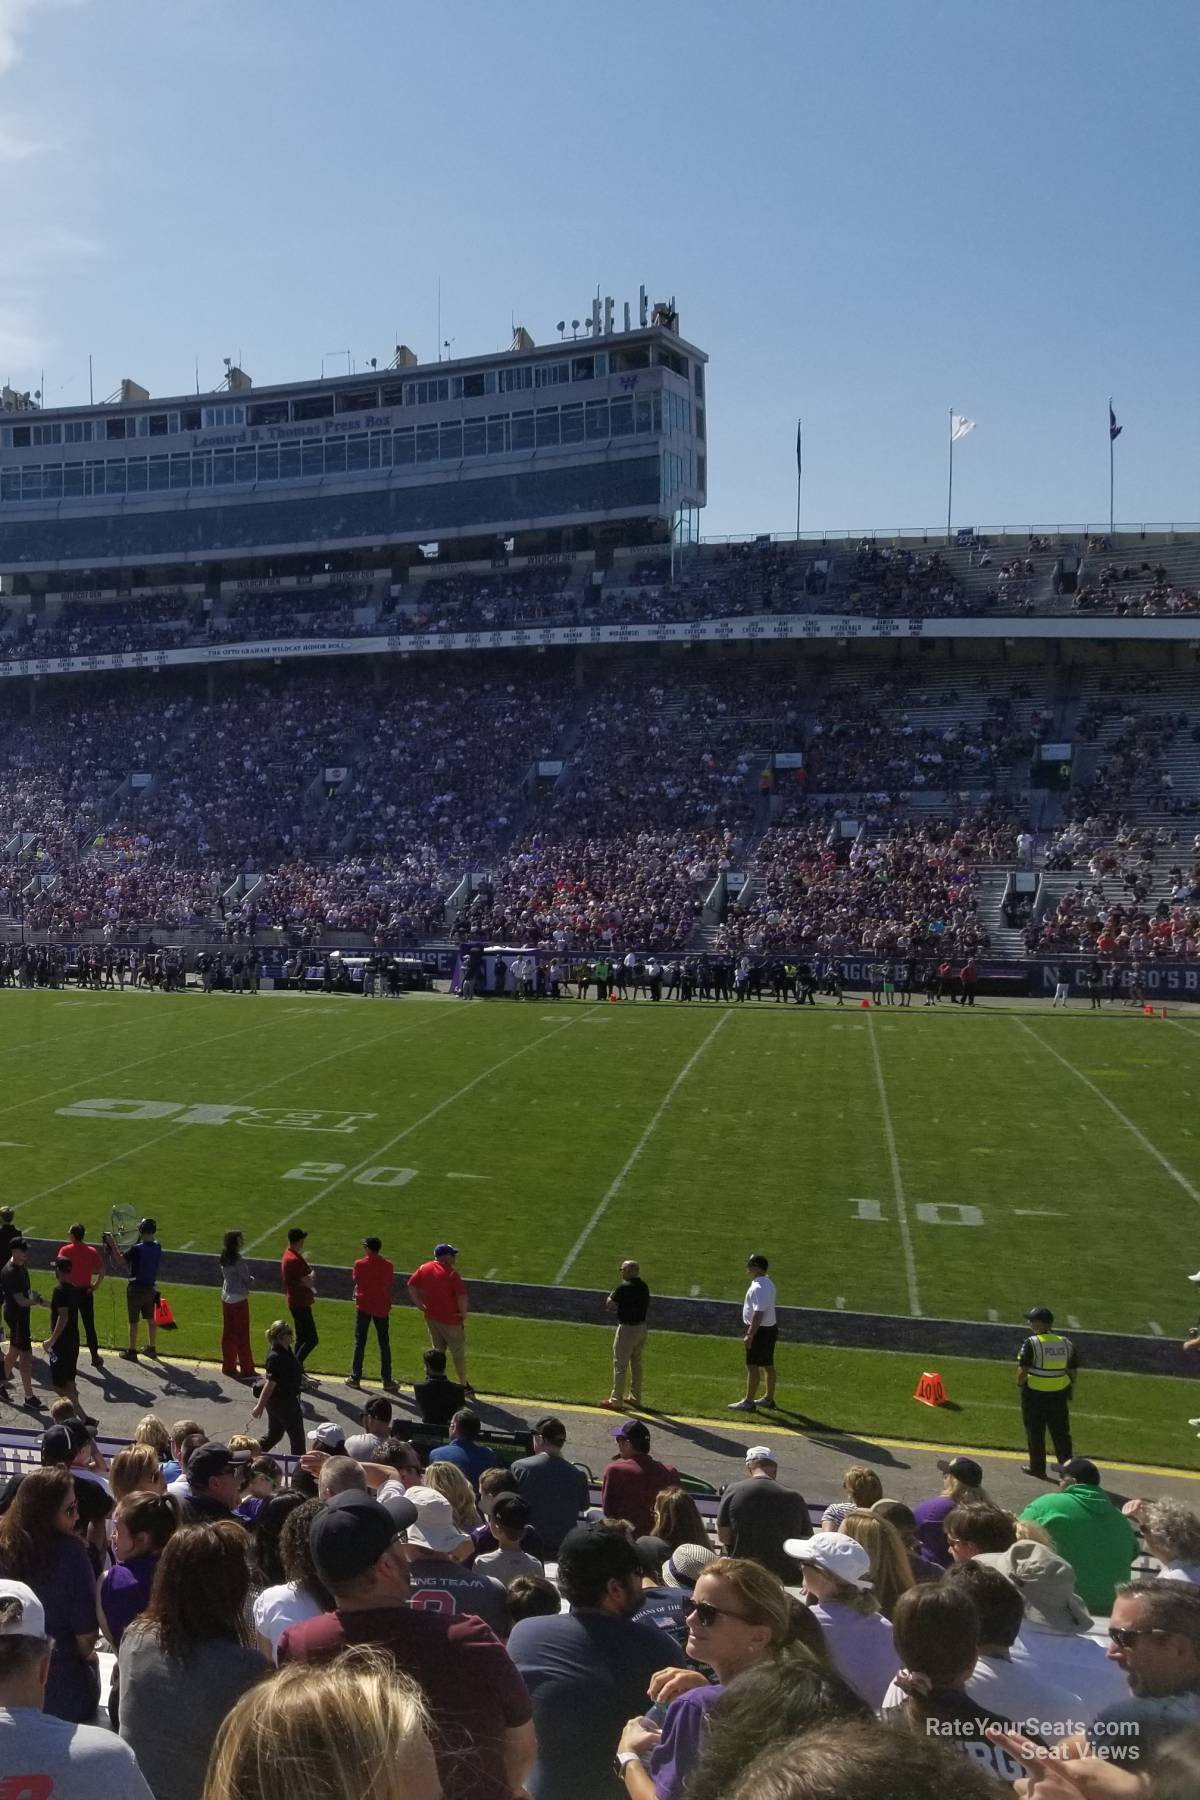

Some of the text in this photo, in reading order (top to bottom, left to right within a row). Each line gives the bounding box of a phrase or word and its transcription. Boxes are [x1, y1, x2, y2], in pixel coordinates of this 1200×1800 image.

[193, 430, 246, 447] Leonard
[269, 423, 320, 439] Thomas
[324, 418, 361, 433] Press
[365, 413, 391, 427] Box
[241, 647, 270, 655] GRAHAM
[281, 1161, 419, 1186] 20
[848, 1198, 984, 1226] 10
[1044, 1347, 1066, 1356] POLICE
[439, 1578, 485, 1589] TEAM
